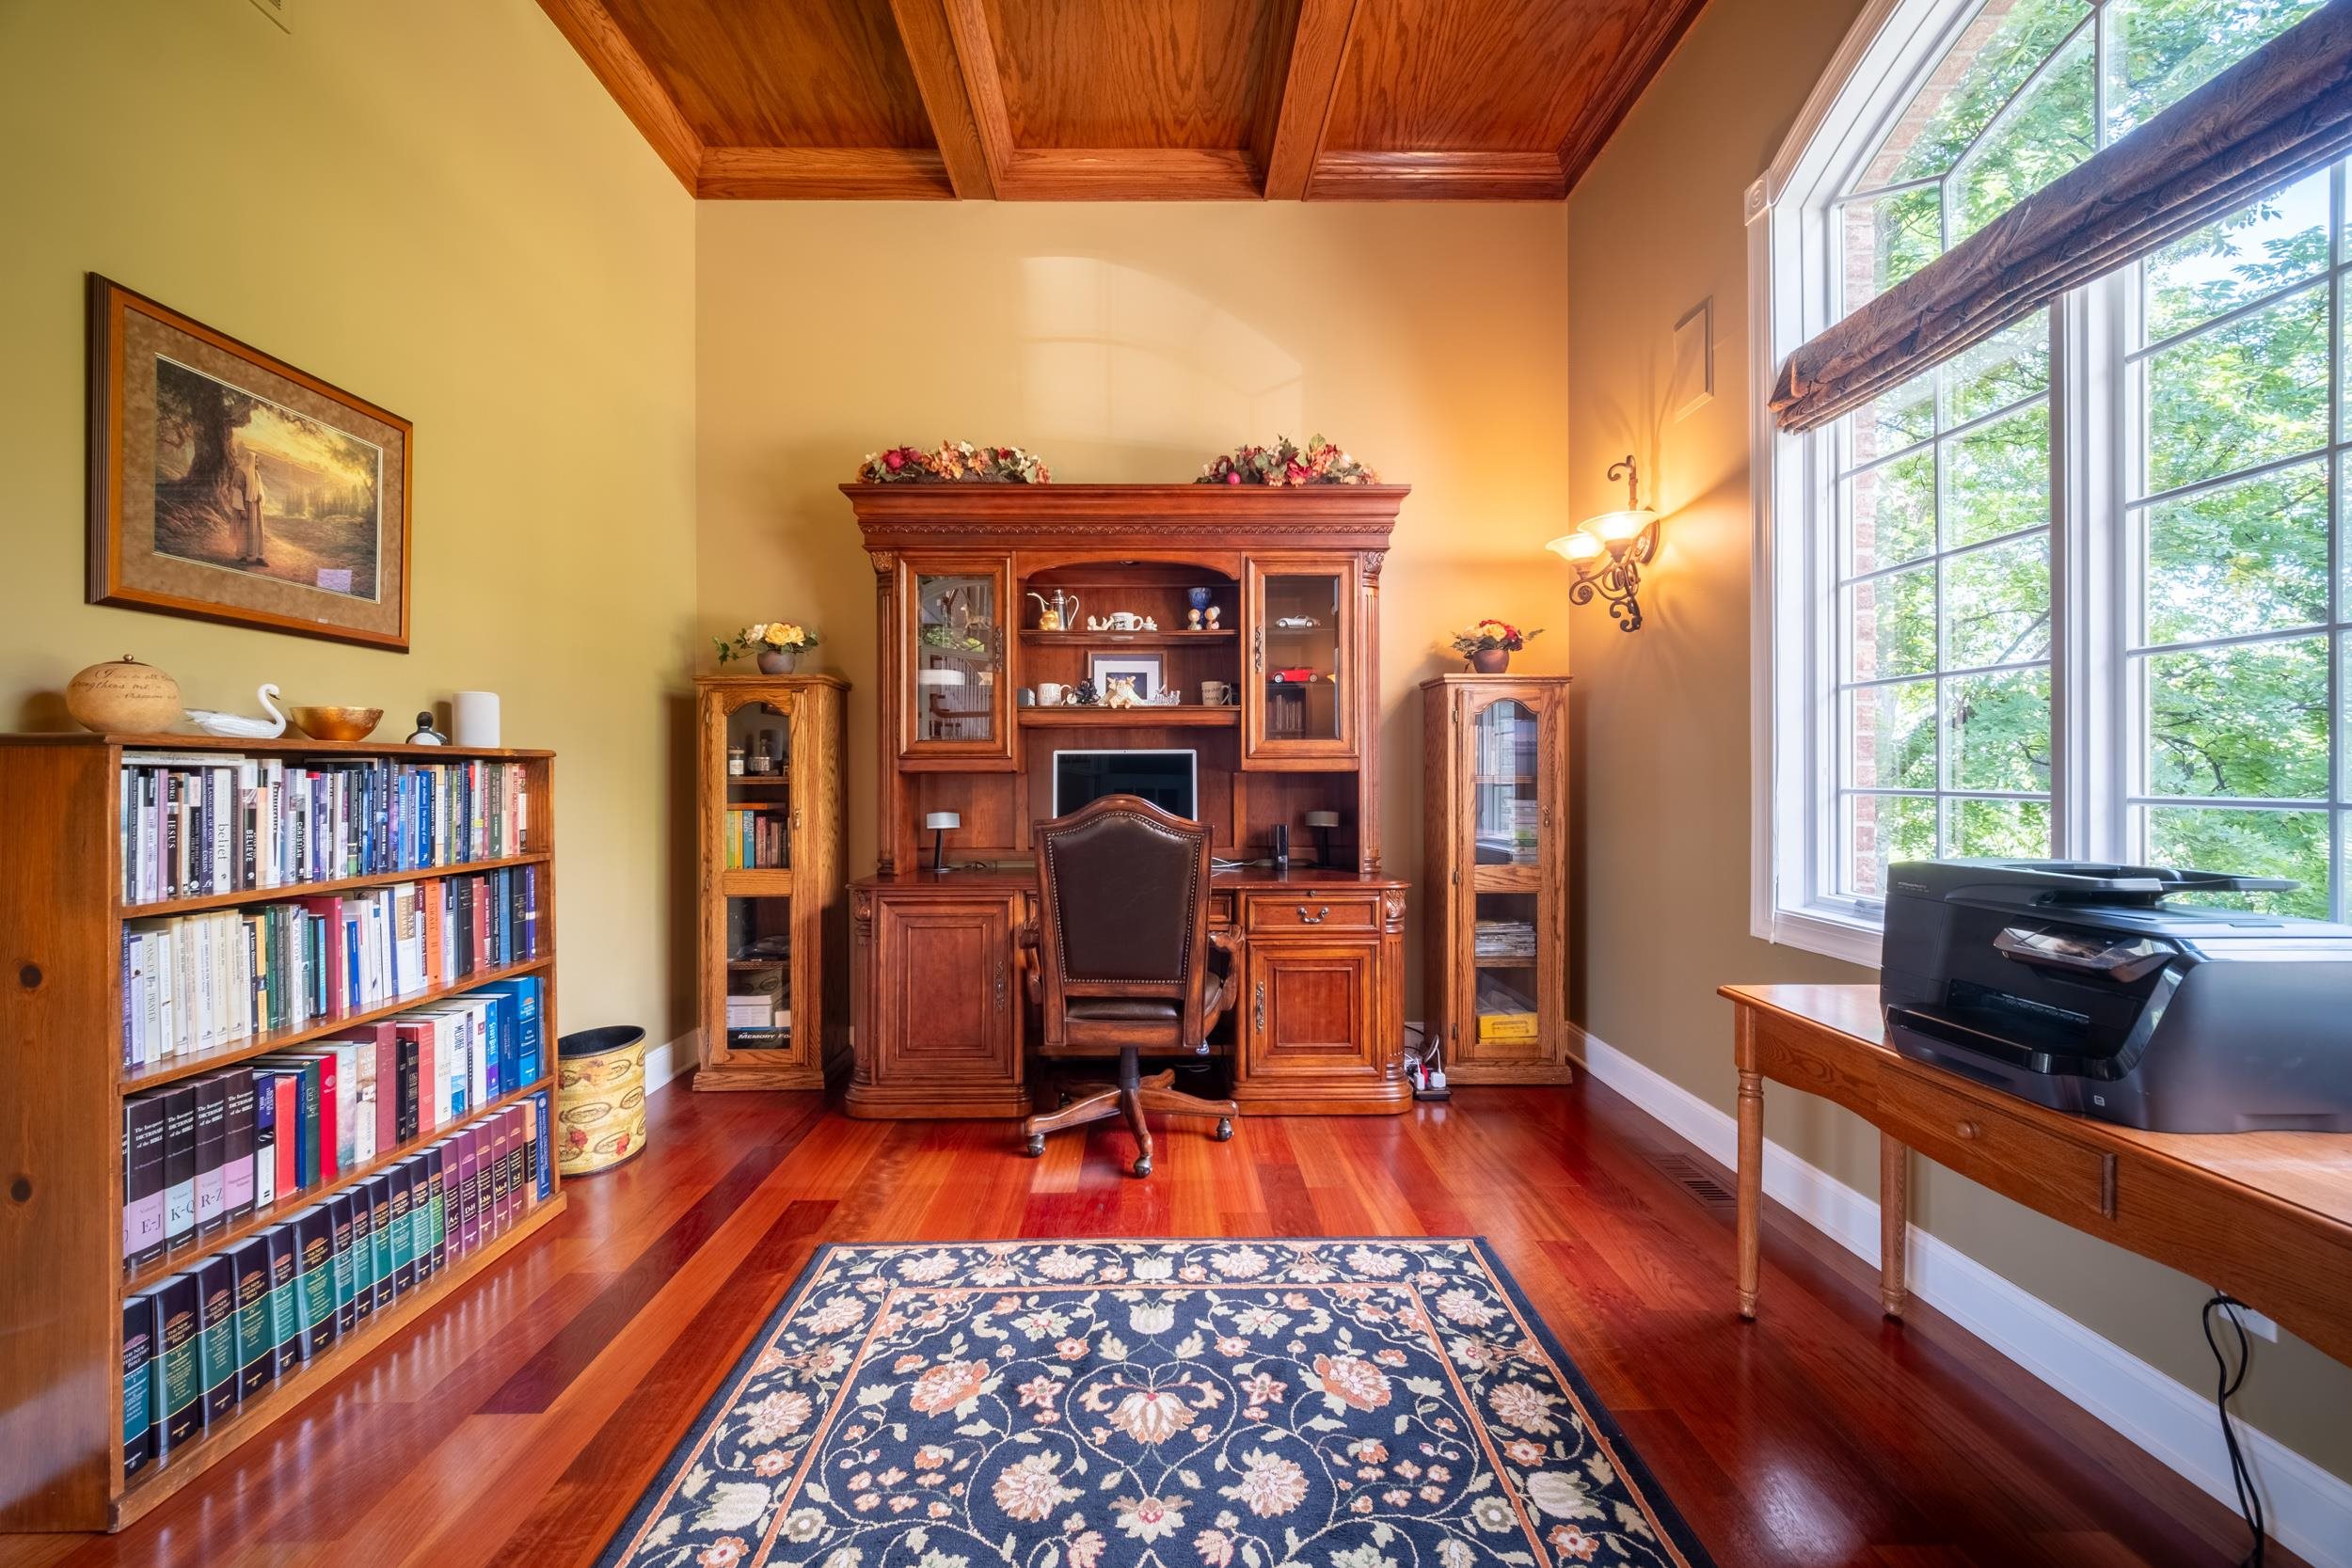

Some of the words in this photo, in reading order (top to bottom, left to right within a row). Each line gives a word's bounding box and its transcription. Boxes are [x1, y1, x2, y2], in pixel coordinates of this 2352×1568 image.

[167, 820, 177, 849] JESUS
[217, 823, 230, 862] belief
[246, 829, 254, 863] BELIEVE
[141, 1213, 161, 1234] E-J
[170, 1199, 195, 1222] K-Q
